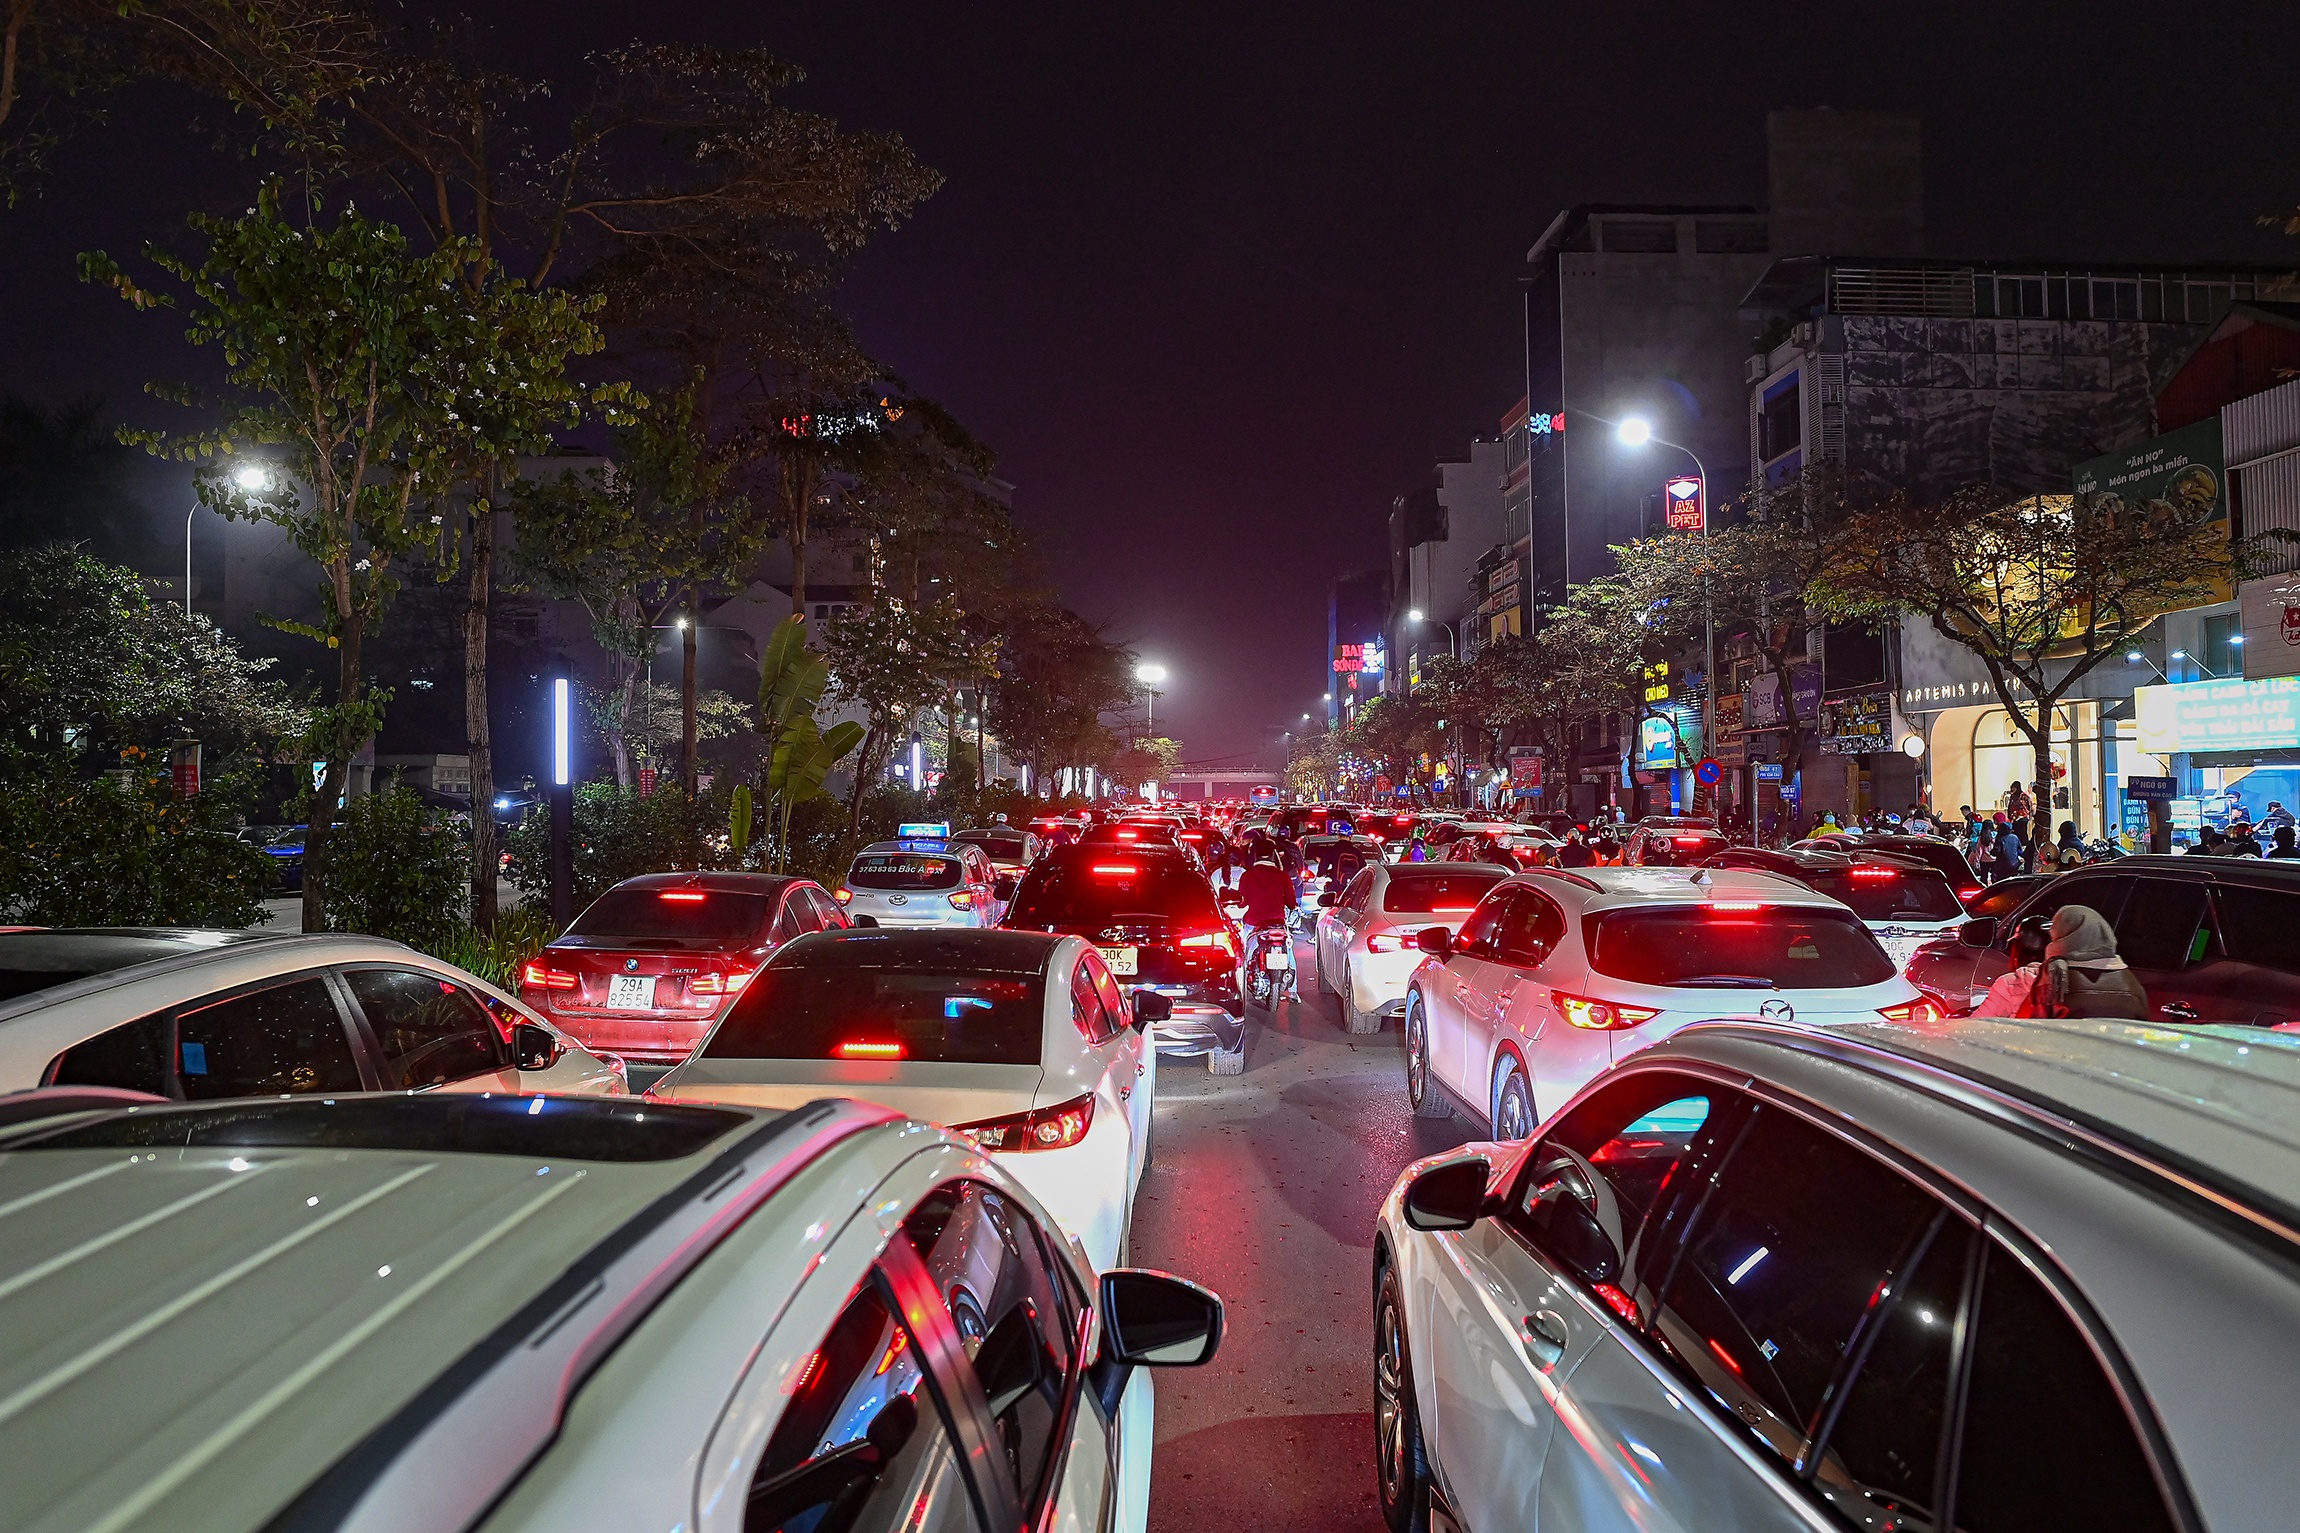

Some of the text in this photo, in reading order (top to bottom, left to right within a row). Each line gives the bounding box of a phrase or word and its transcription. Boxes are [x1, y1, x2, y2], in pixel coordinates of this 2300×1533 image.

[2108, 474, 2127, 487] Món
[2128, 467, 2151, 482] ngon
[2152, 462, 2164, 473] ba
[1675, 500, 1695, 513] AZ
[1671, 513, 1699, 527] PET
[1906, 683, 1966, 703] ARTEMIS
[2211, 684, 2246, 698] CANH
[1760, 692, 1771, 705] SCB
[2262, 699, 2290, 713] CAY
[2140, 780, 2167, 789] NGÕ 69
[2127, 805, 2141, 815] BÚN
[1102, 949, 1123, 960] 30K
[620, 978, 643, 992] 29A
